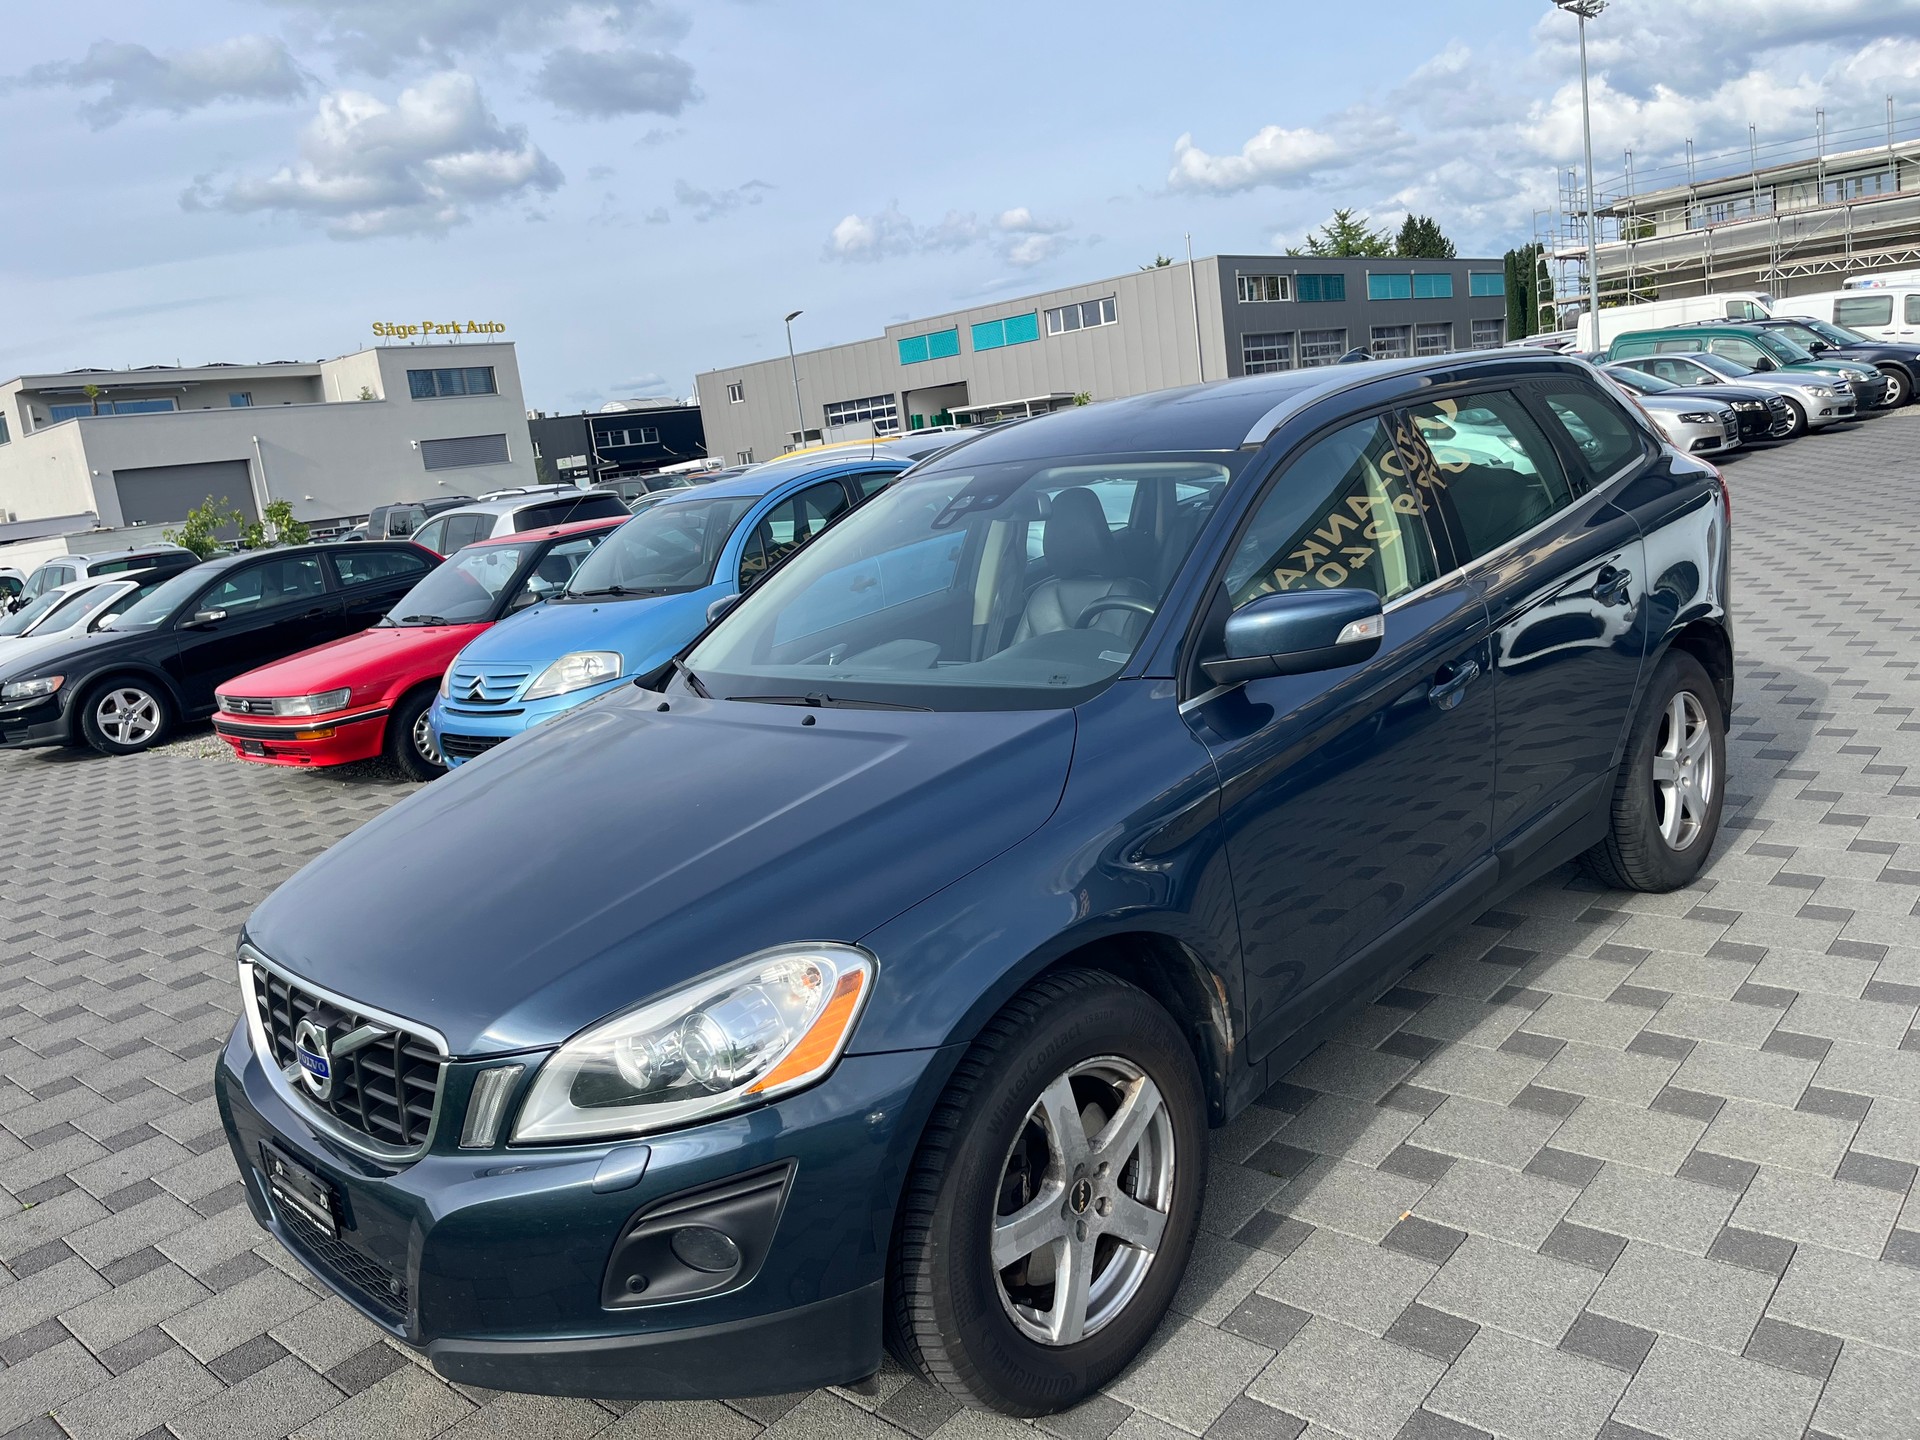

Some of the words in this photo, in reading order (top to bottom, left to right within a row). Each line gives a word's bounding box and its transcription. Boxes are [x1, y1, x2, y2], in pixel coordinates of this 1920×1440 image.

[372, 321, 418, 339] Säge
[422, 321, 462, 335] Park
[467, 320, 506, 333] Auto
[299, 1052, 326, 1072] VOLVO
[987, 1021, 1081, 1134] WinterContact
